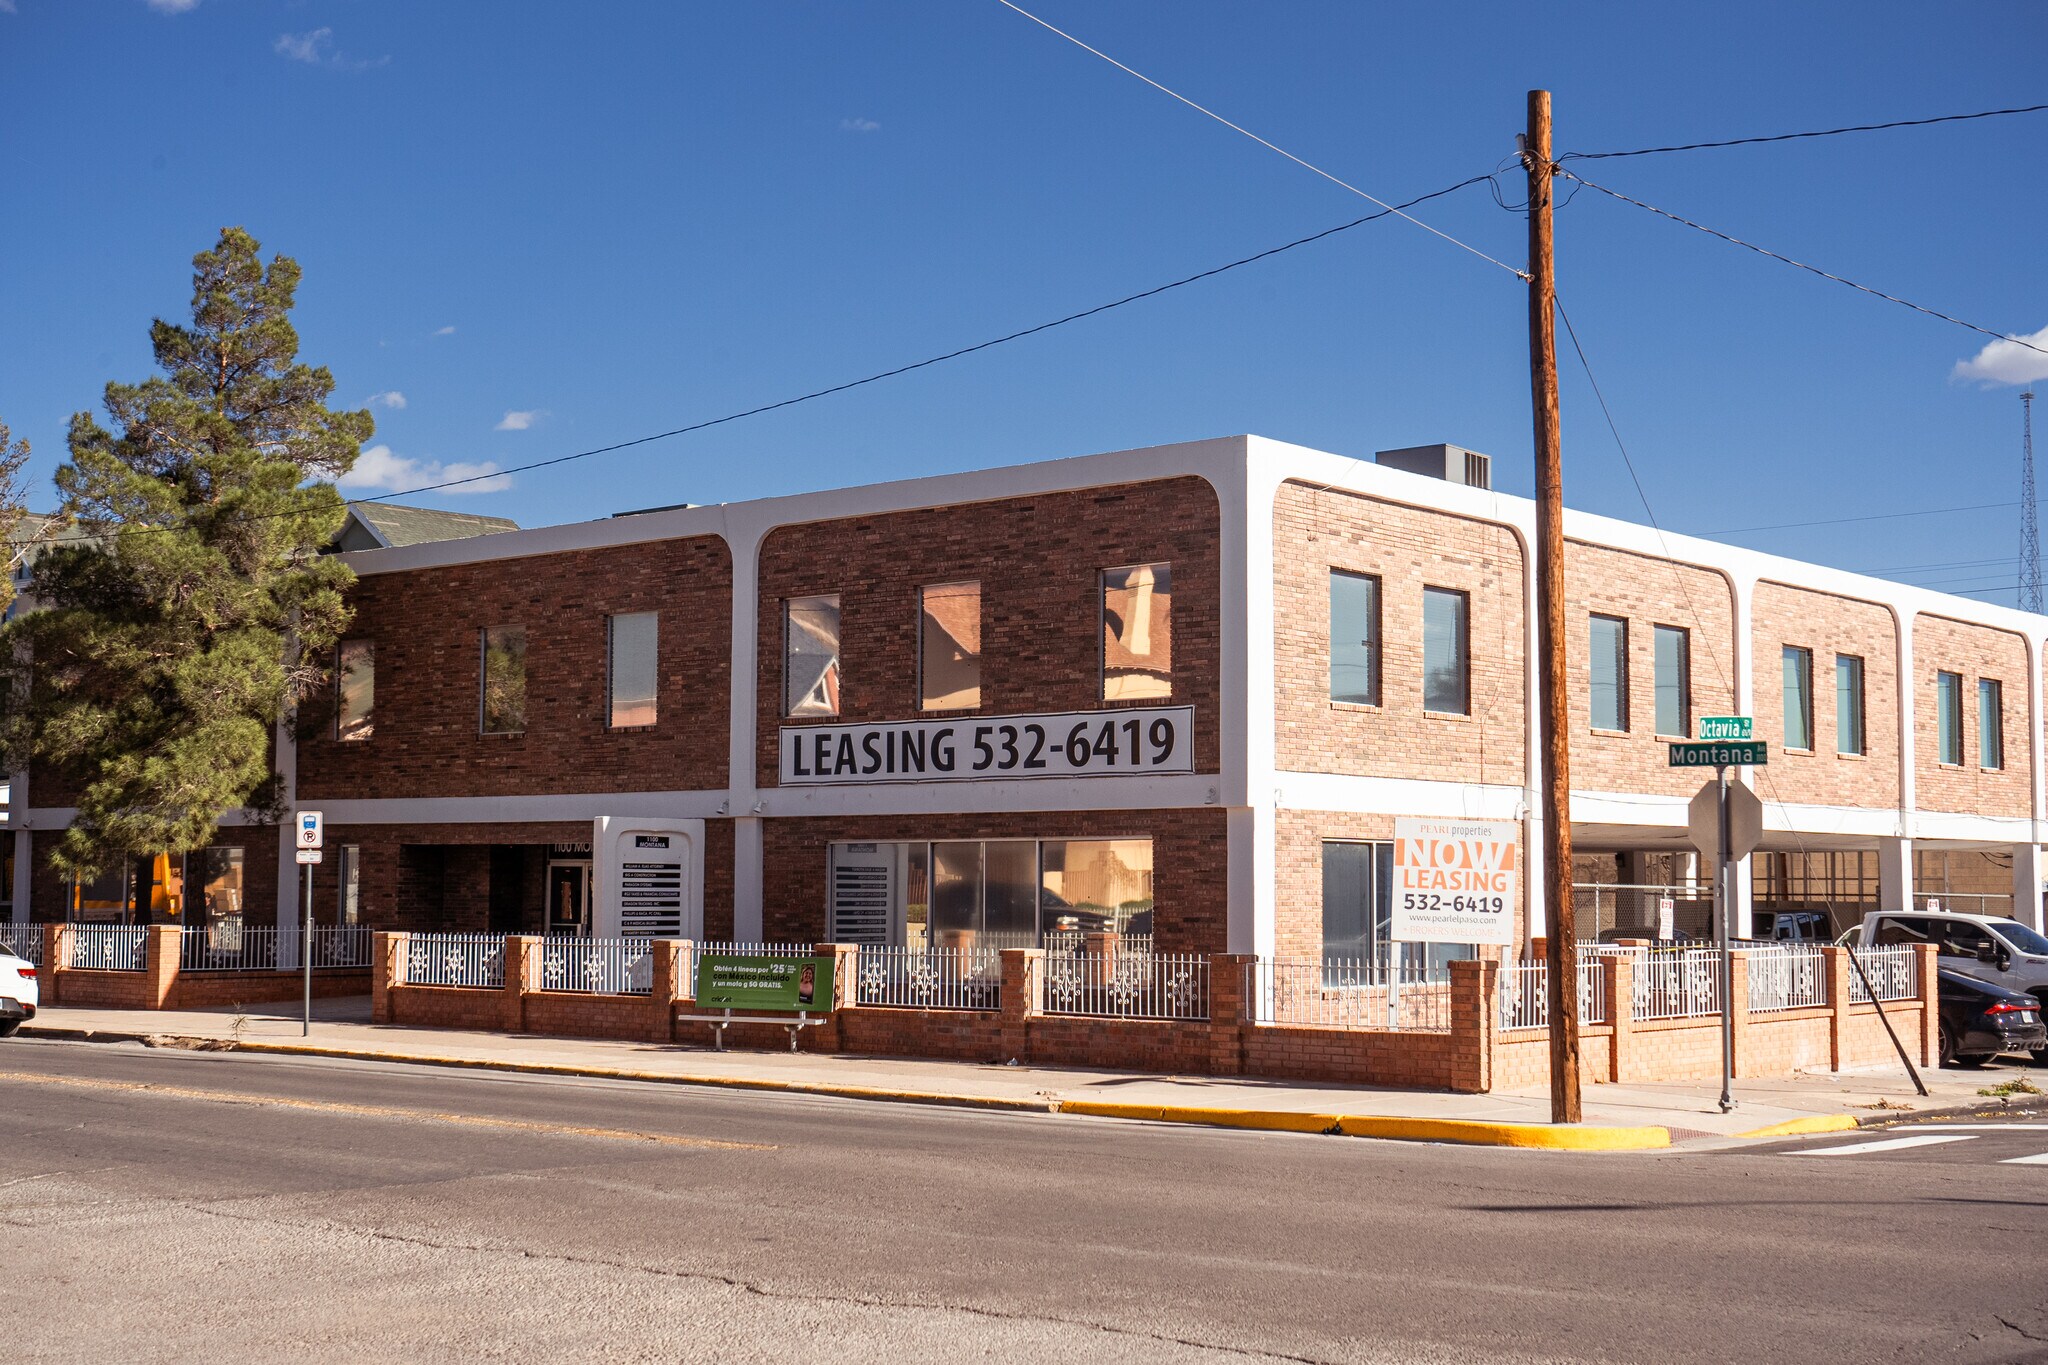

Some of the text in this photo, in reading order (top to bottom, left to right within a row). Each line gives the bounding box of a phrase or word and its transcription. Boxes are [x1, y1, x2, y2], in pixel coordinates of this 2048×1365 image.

[1700, 719, 1740, 738] Octavia
[793, 717, 1175, 777] LEASING 532-6419
[1671, 746, 1753, 764] Montana
[1451, 825, 1492, 838] properties
[1404, 838, 1509, 871] NOW
[1403, 869, 1507, 893] LEASING
[1404, 893, 1503, 914] 532-6419
[1409, 914, 1497, 925] www.pearlelpaso.com
[1410, 925, 1494, 938] BROKERS WELCOME
[729, 972, 757, 980] México
[758, 973, 790, 982] incluido
[758, 981, 783, 989] GRATIS.
